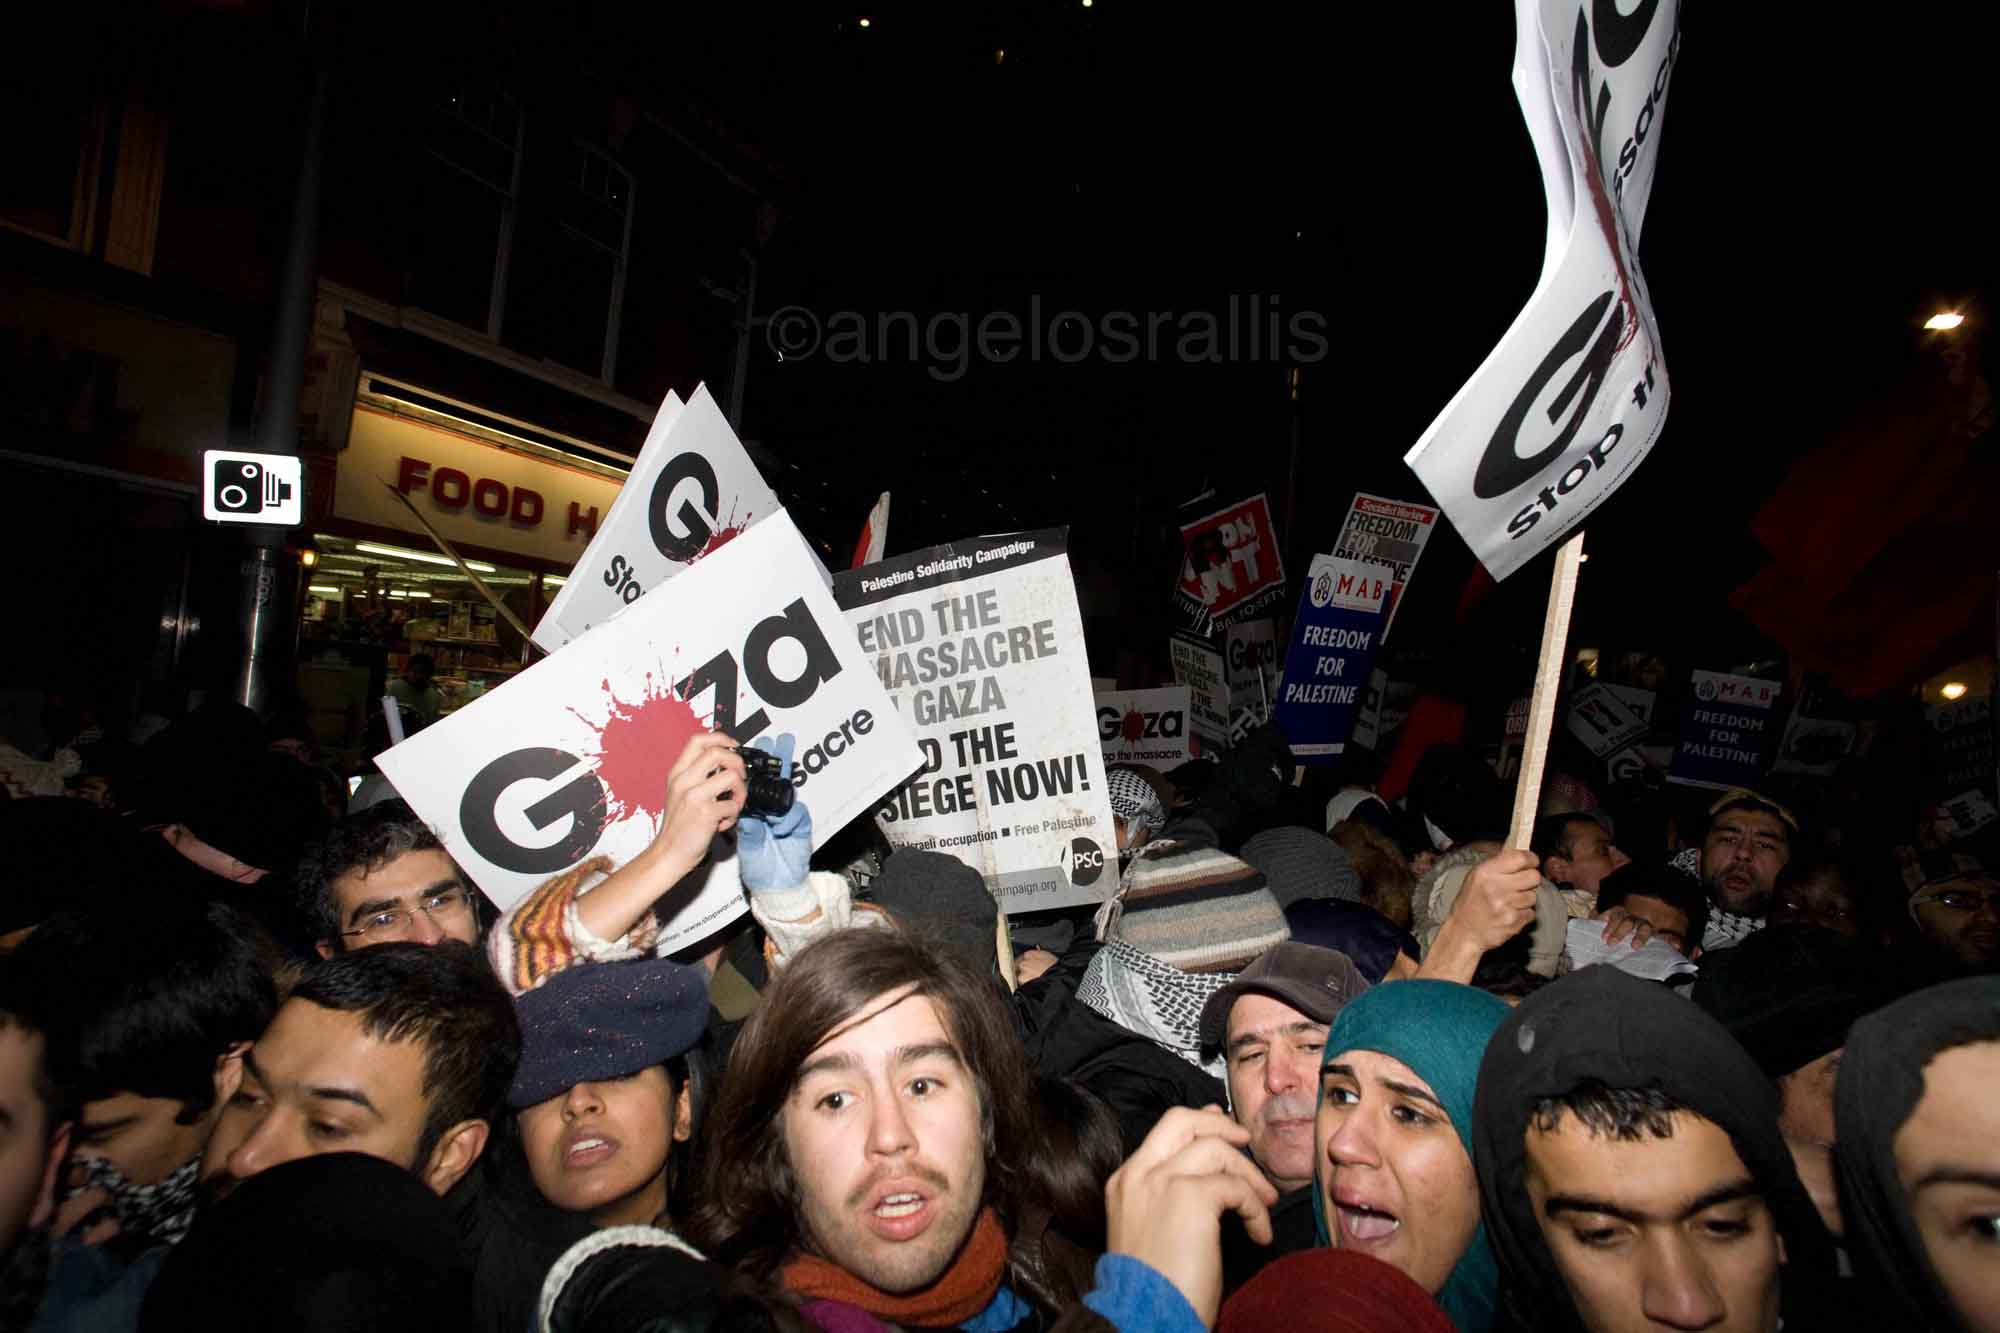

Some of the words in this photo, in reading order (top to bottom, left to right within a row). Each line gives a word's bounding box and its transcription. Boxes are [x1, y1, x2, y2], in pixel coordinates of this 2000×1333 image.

[398, 456, 545, 526] FOOD
[1506, 423, 1624, 541] Stop
[1347, 511, 1419, 541] FREEDOM
[1345, 532, 1378, 554] FOR
[604, 555, 648, 605] Sto
[861, 570, 915, 593] Palestine
[916, 555, 973, 579] Solidarity
[975, 541, 1036, 564] Campaign
[857, 608, 925, 654] END
[931, 588, 1001, 636] THE
[1302, 624, 1371, 651] FREEDOM
[1314, 656, 1345, 677] FOR
[913, 675, 1007, 726] GAZA
[1284, 683, 1359, 704] PALESTINE
[1693, 709, 1765, 731] FREEDOM
[792, 709, 874, 788] sacre
[949, 721, 1018, 769] THE
[1709, 729, 1740, 744] FOR
[1118, 750, 1131, 760] the
[1134, 750, 1182, 760] massacre
[1681, 741, 1761, 766] PALESTINE
[881, 774, 977, 823] SIEGE
[986, 753, 1091, 806] NOW!
[939, 830, 998, 848] occupation
[1014, 824, 1040, 837] Free
[1042, 814, 1097, 833] Palestine
[1073, 850, 1103, 869] PSC
[990, 880, 1057, 897] campaign.org
